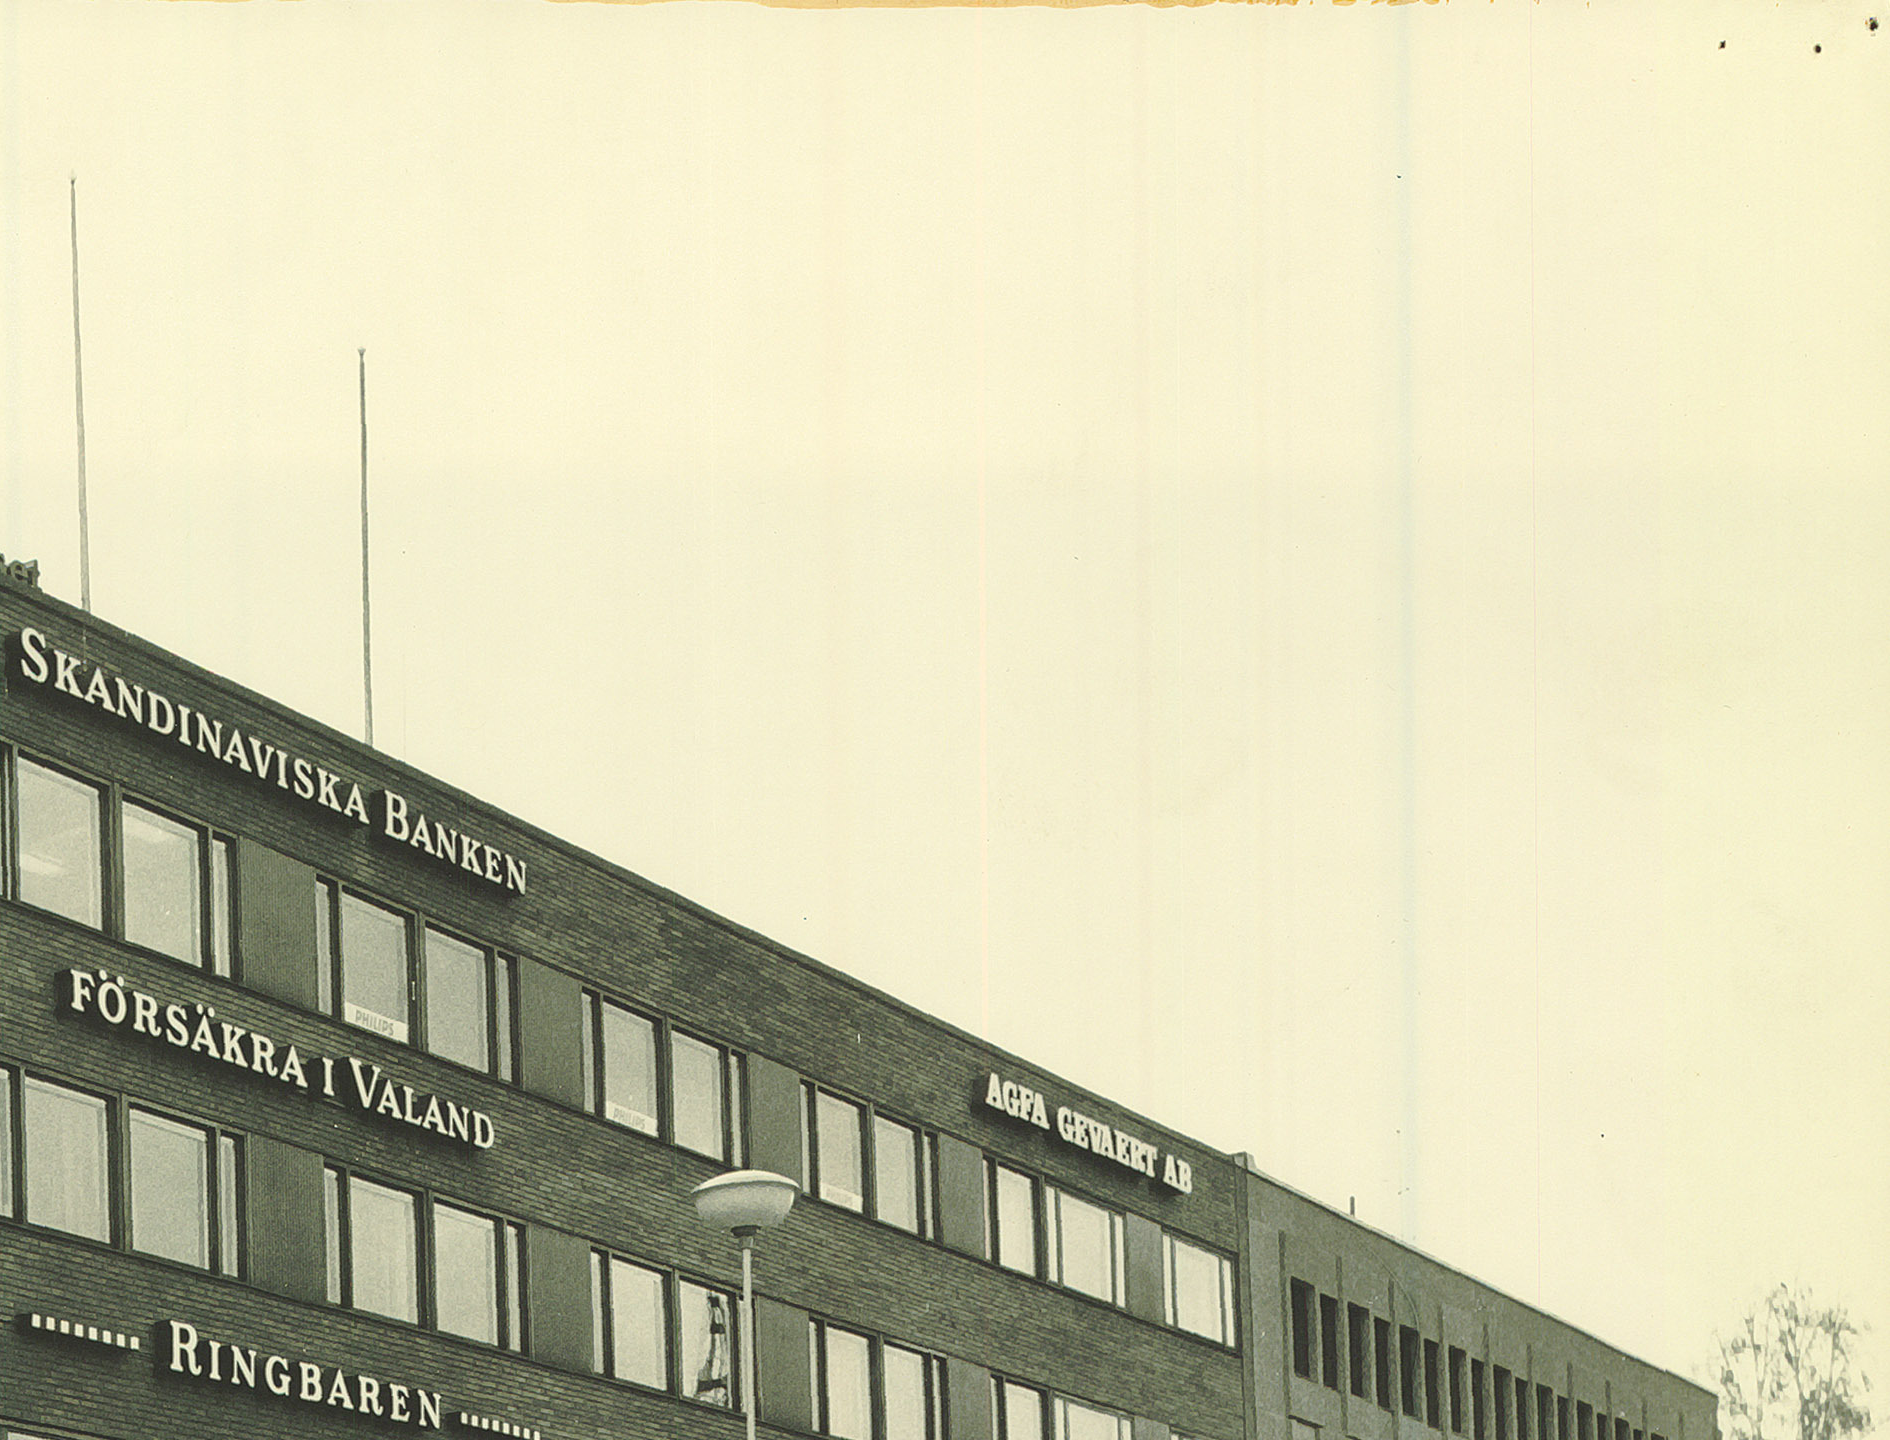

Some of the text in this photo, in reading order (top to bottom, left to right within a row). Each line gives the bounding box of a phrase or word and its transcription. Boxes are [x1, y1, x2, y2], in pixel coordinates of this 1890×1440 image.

[20, 627, 527, 895] SKANDINAVISKA BANKEN
[70, 968, 496, 1149] FÖRSÄKRA I VALAND
[355, 1009, 395, 1036] PHILIPS
[985, 1072, 1193, 1194] AGFA GEVAERT AB
[169, 1319, 442, 1430] RINGBAREN
